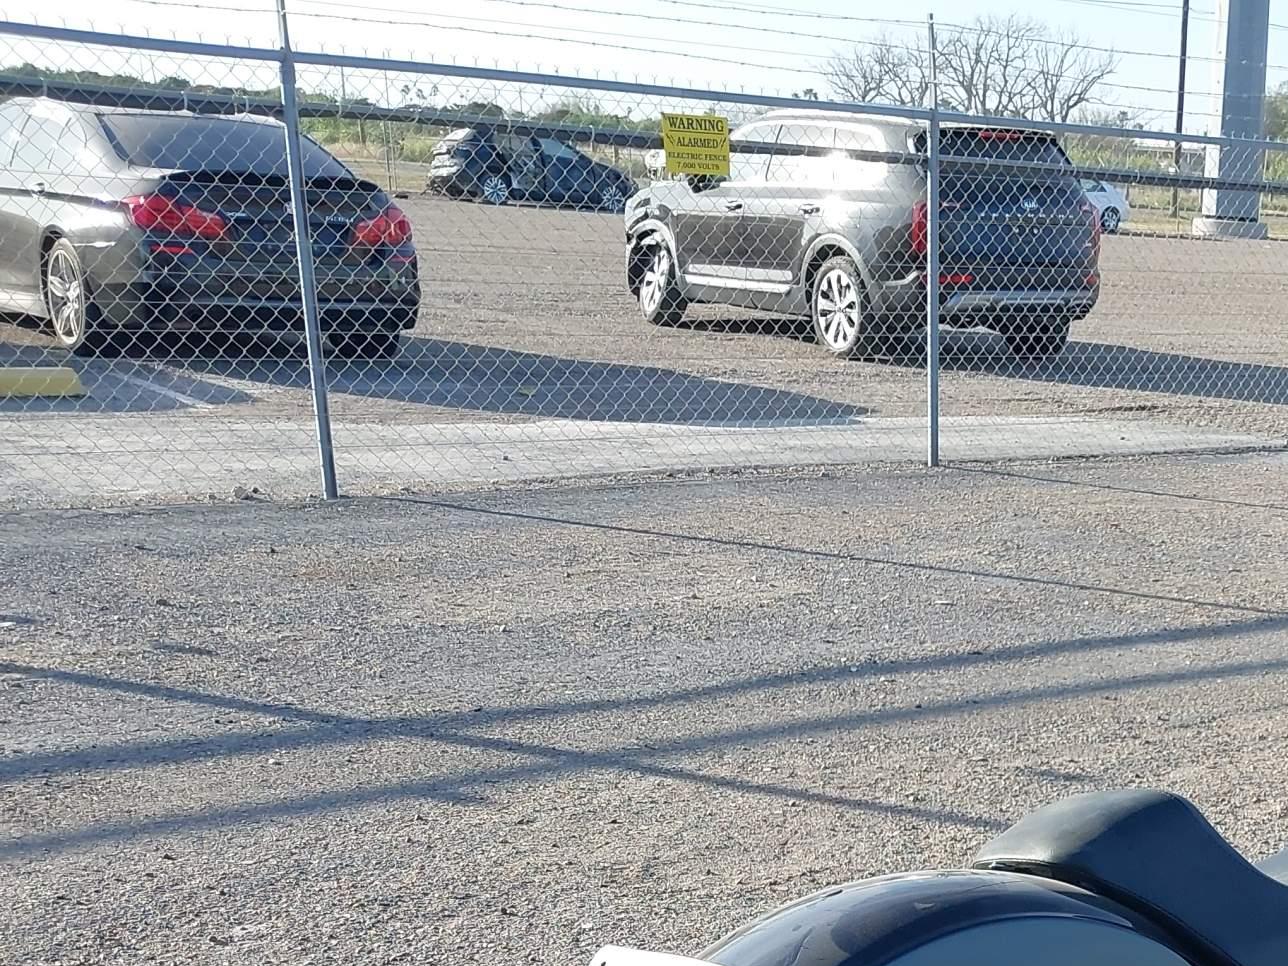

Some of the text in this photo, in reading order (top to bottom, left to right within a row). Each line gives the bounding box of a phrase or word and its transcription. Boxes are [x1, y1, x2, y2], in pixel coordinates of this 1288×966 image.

[668, 117, 724, 131] WARNING
[677, 137, 718, 148] ALARMED
[668, 152, 703, 160] ELECTRIC
[676, 161, 696, 170] 7,000
